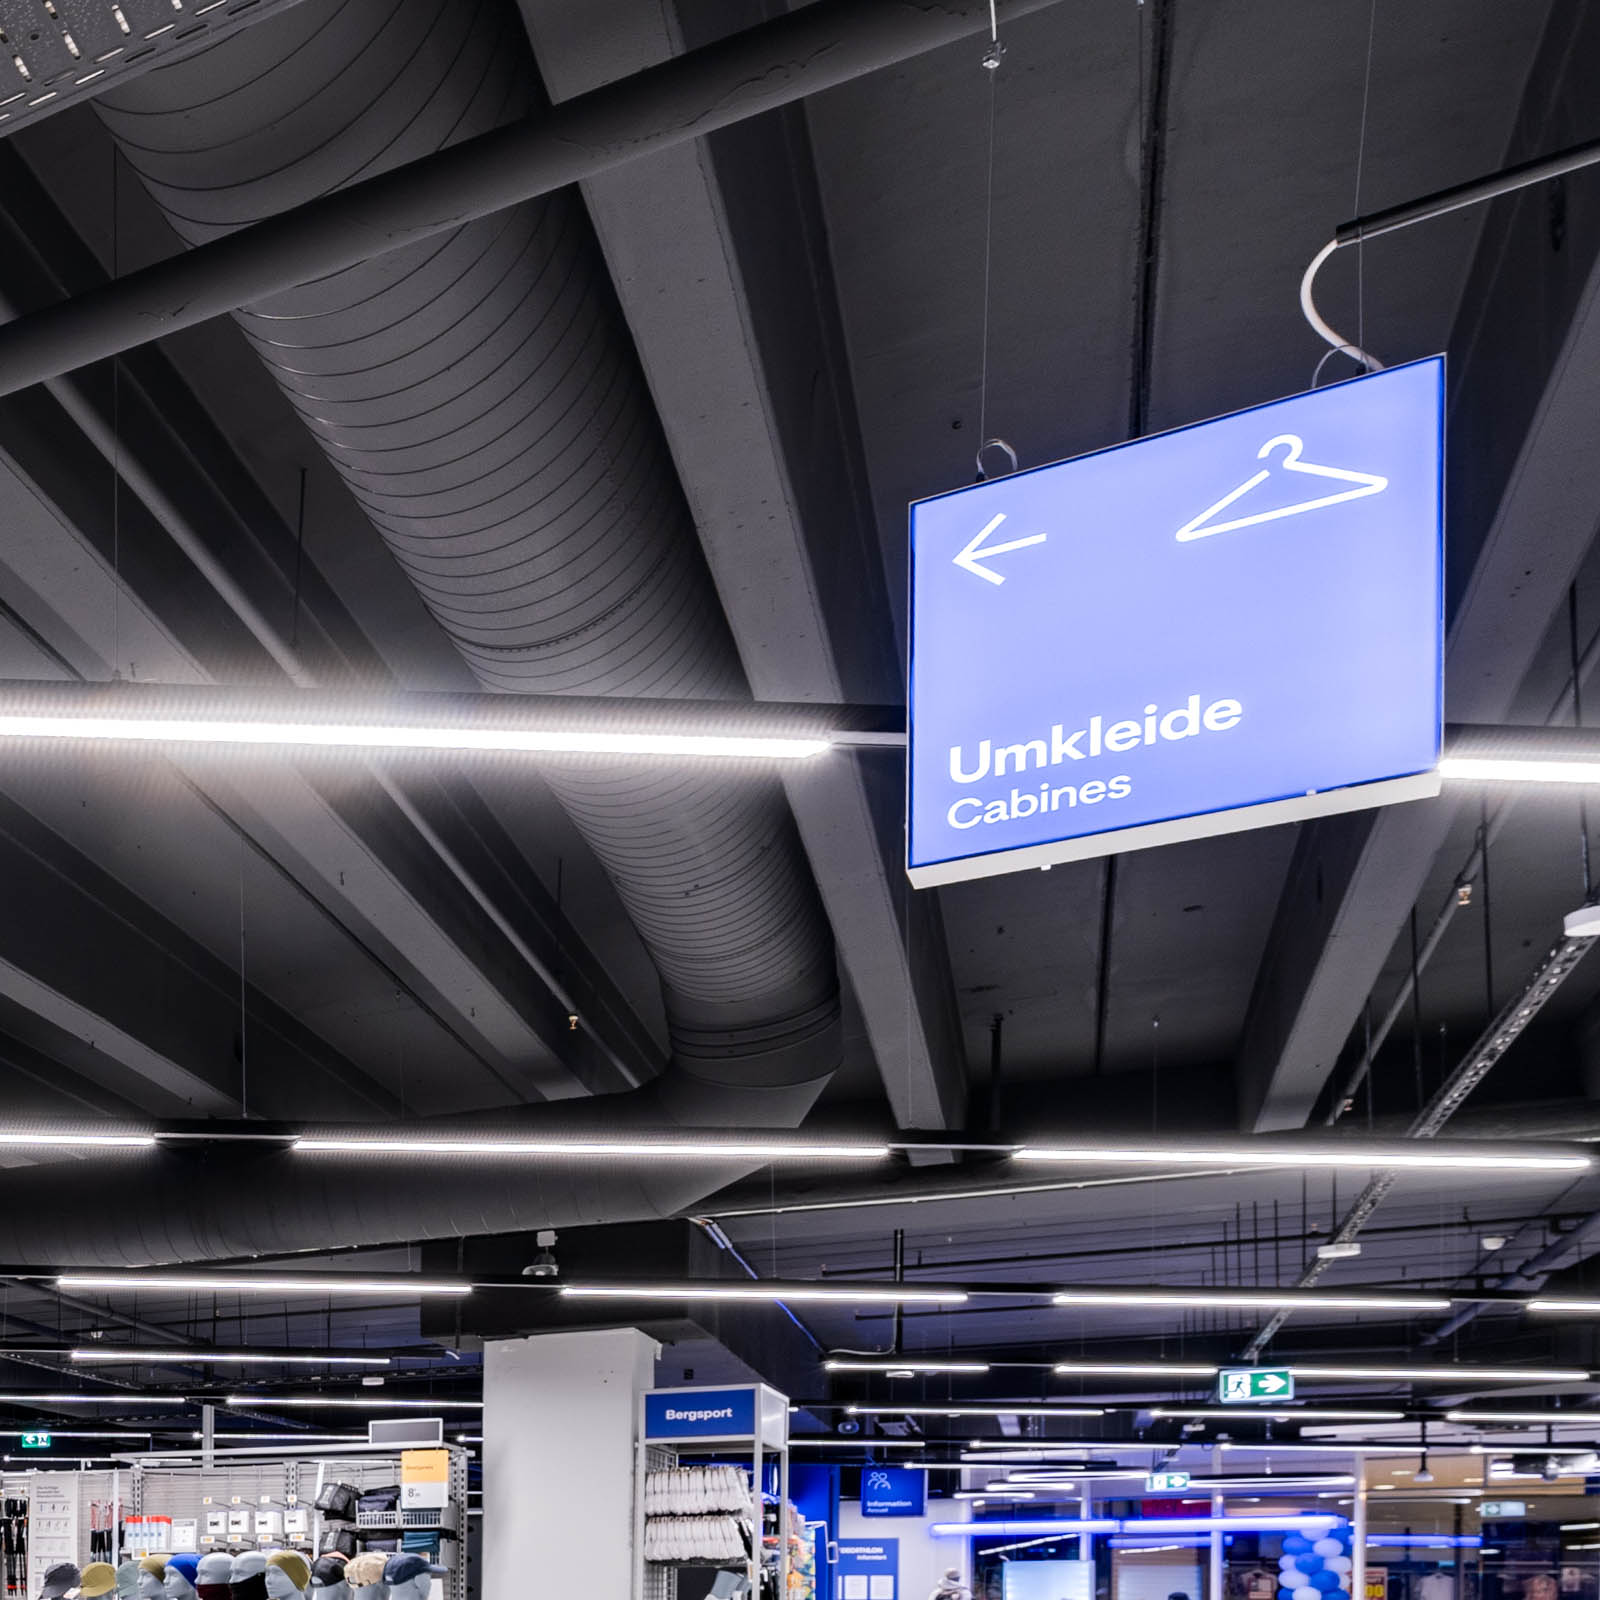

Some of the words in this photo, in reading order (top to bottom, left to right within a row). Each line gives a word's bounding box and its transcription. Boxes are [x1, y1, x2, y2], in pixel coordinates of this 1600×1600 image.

[949, 694, 1243, 784] Umkleide
[947, 774, 1132, 829] Cabines
[665, 1408, 733, 1421] Bergsport
